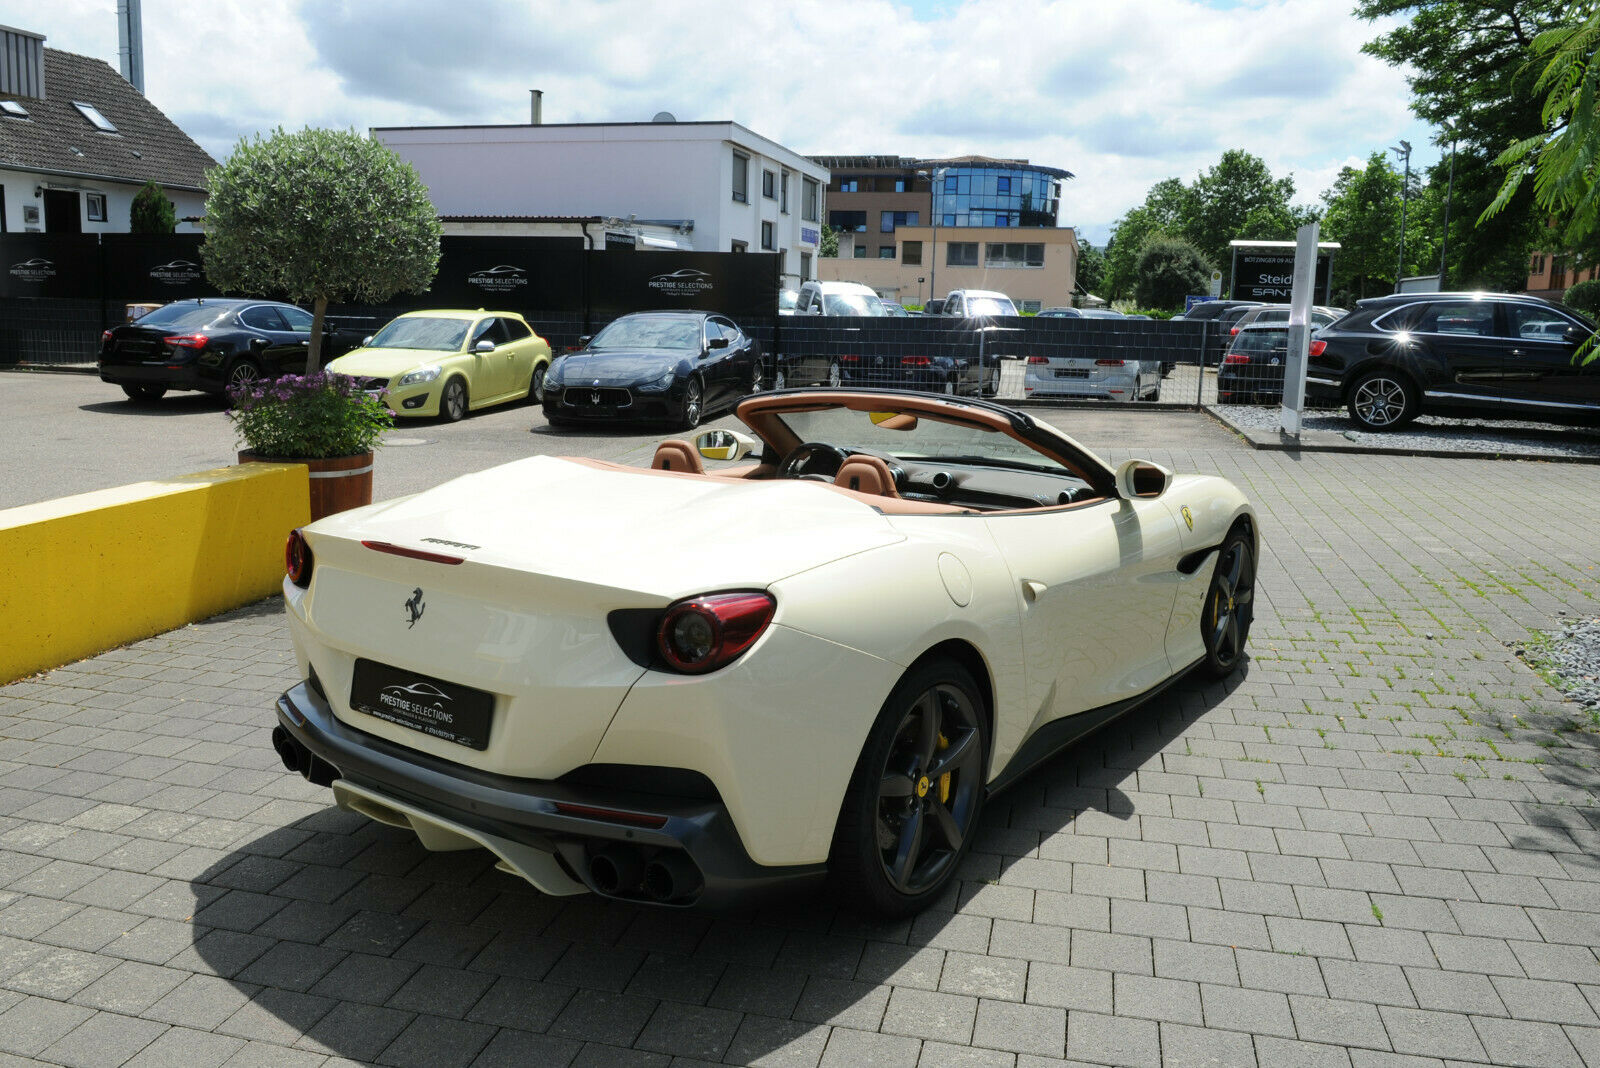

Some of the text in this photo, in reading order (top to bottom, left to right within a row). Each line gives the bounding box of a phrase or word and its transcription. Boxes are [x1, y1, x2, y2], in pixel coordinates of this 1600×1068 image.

[1258, 273, 1294, 285] Steid
[648, 281, 713, 290] PRESTIGE SELECTIONS
[1252, 287, 1293, 297] SANT
[380, 693, 410, 711] PRESTIGE
[411, 702, 454, 724] SELECTIONS
